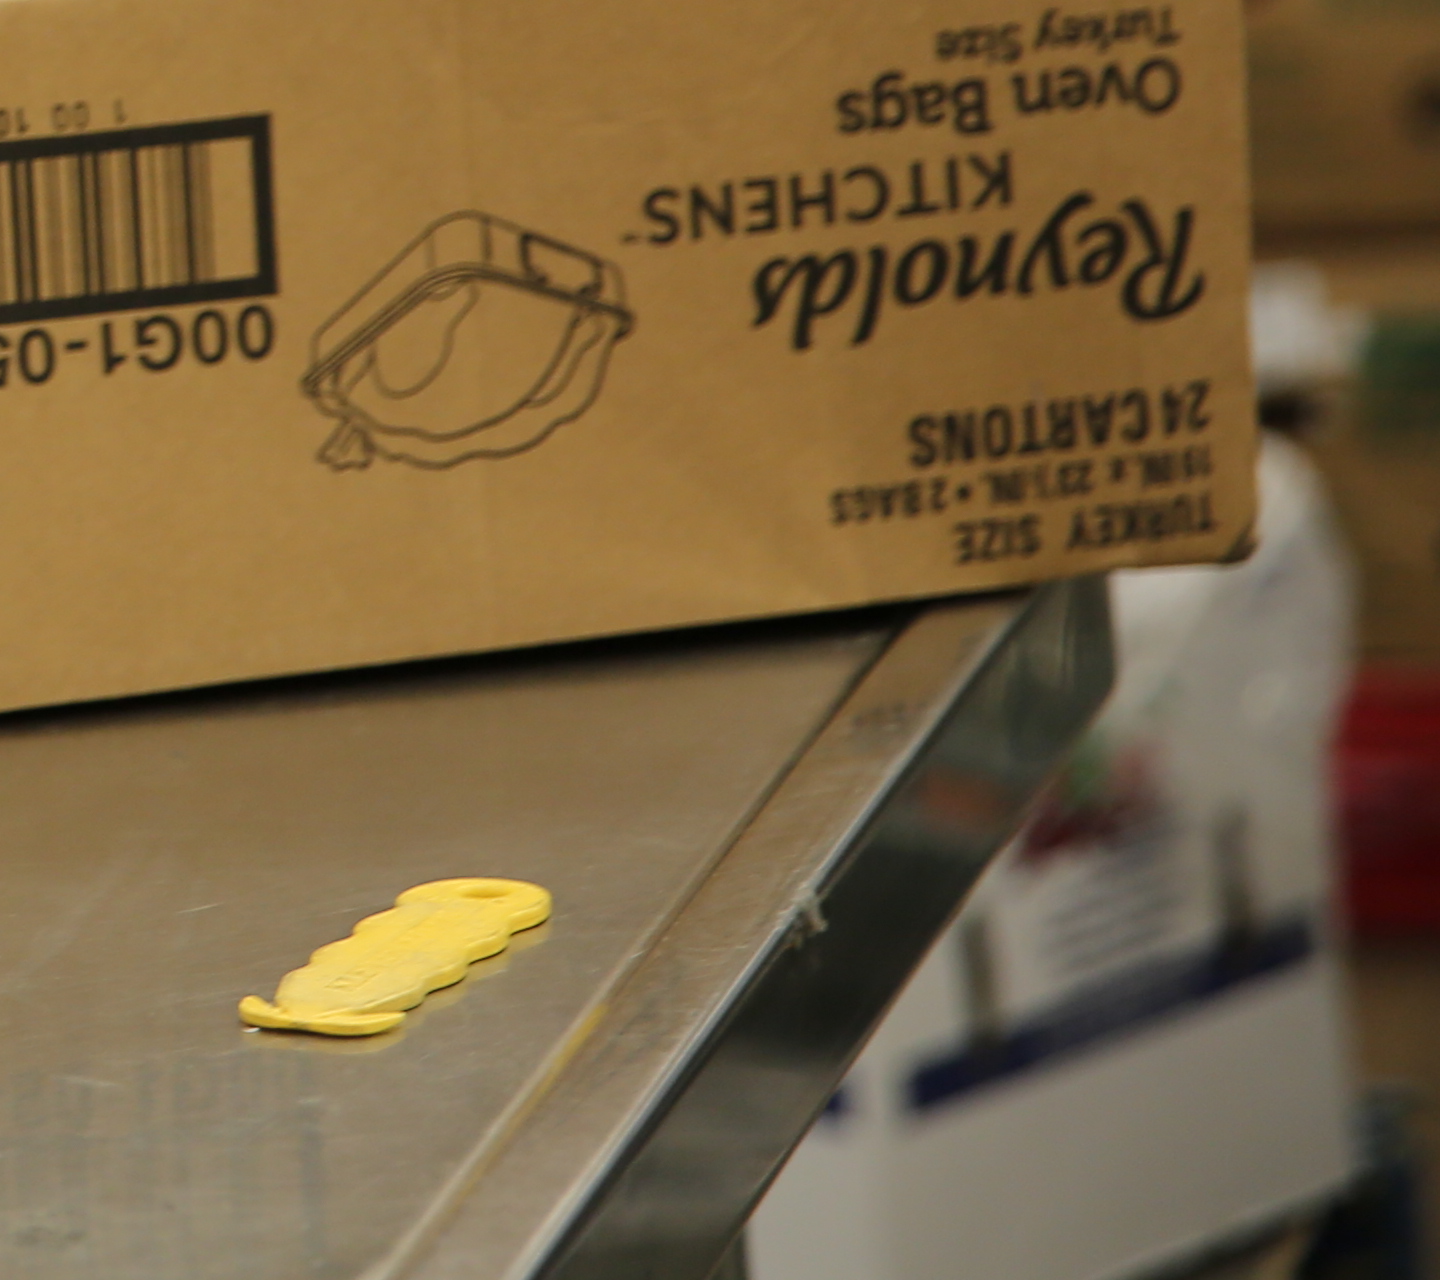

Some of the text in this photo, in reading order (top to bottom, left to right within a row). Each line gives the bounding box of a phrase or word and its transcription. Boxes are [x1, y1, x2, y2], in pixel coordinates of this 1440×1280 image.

[935, 5, 1183, 65] Turkey Size
[835, 55, 1182, 134] Oven Bags
[642, 149, 1015, 246] KITCHENS
[750, 189, 1206, 351] Reynolds
[908, 388, 1150, 468] CARTONS
[954, 490, 1216, 566] TURKEY SIZE
